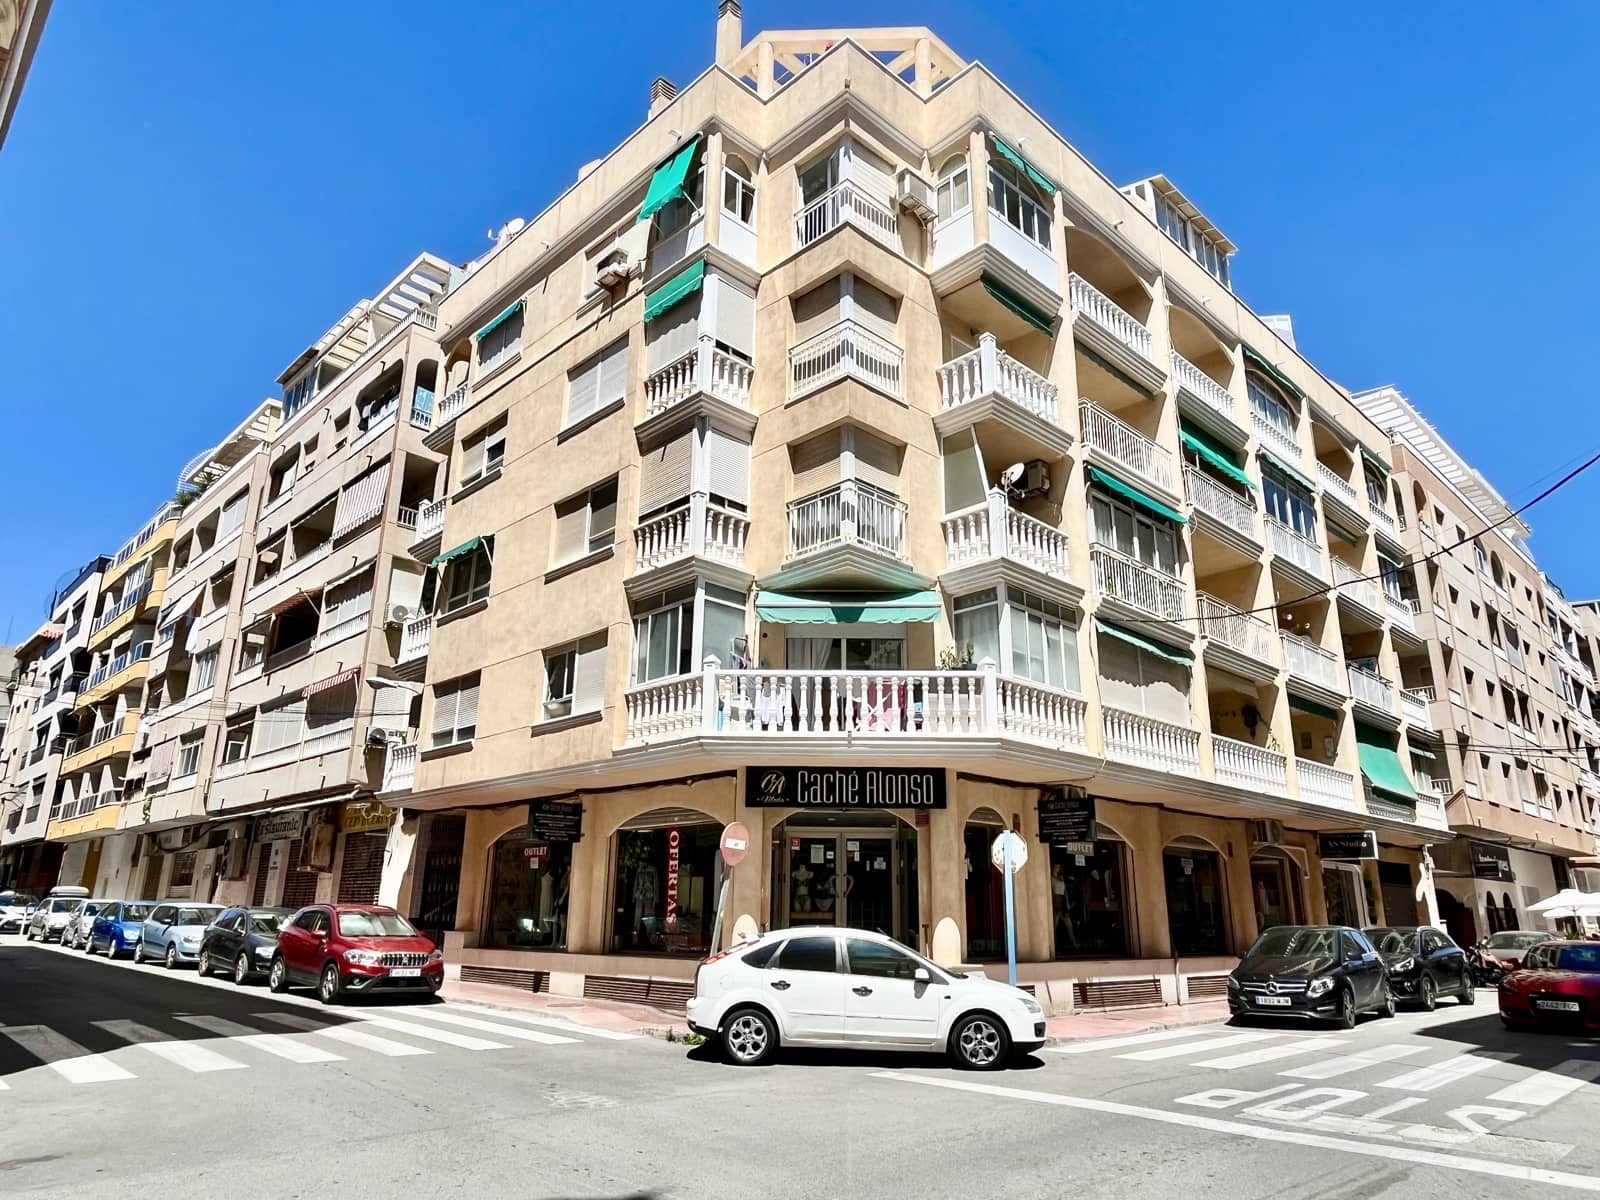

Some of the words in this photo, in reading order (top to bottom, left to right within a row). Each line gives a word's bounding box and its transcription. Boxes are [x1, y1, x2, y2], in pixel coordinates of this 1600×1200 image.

[797, 770, 859, 804] Caché
[866, 770, 935, 805] Alonso
[524, 846, 548, 856] OUTLET
[1067, 842, 1093, 853] OUTLET
[666, 830, 680, 924] OFERTAS
